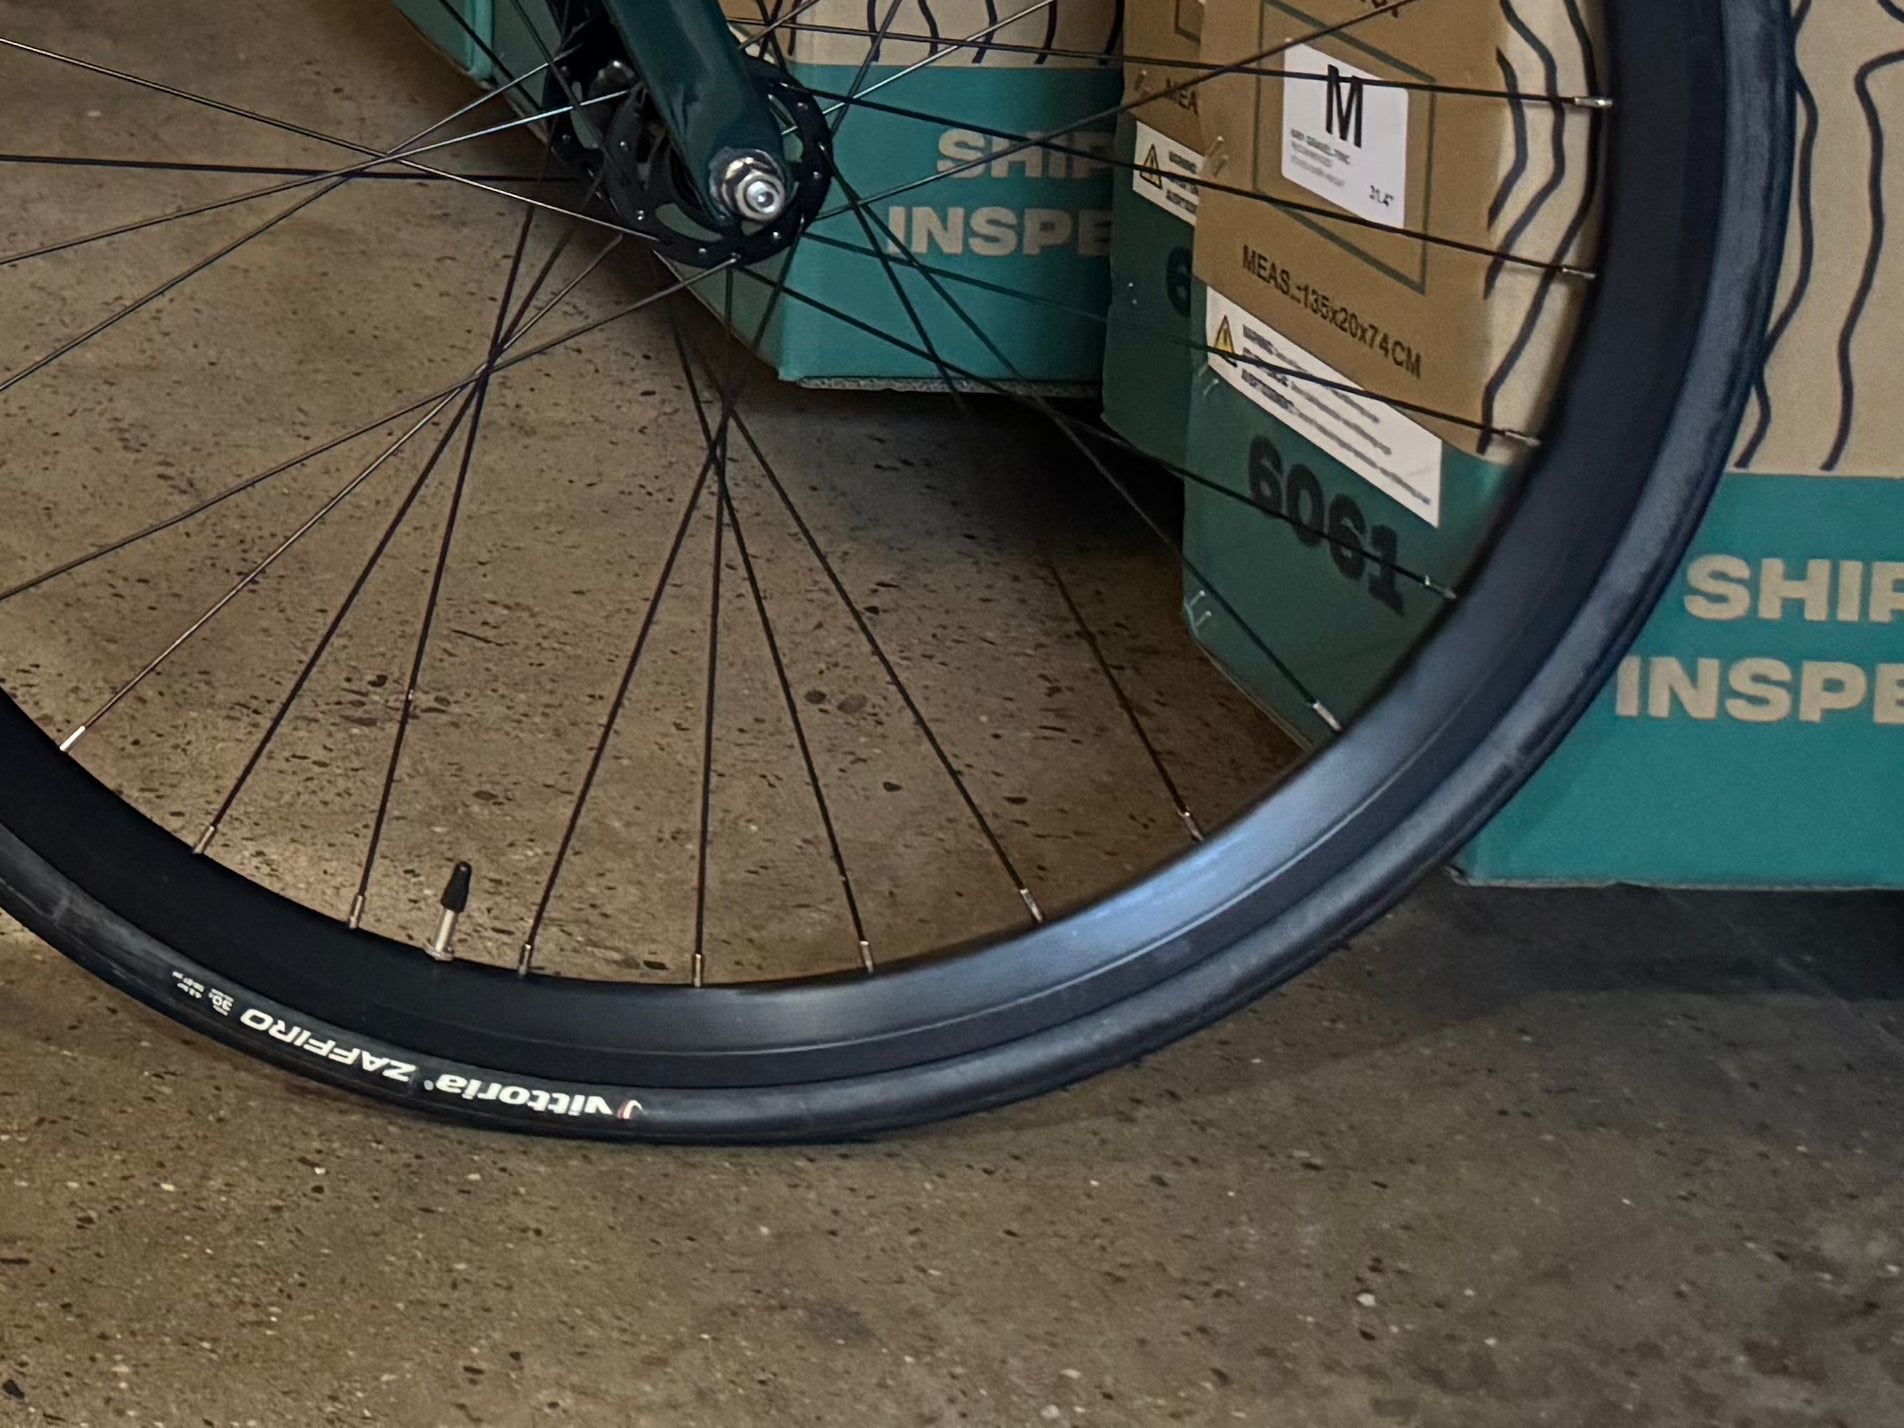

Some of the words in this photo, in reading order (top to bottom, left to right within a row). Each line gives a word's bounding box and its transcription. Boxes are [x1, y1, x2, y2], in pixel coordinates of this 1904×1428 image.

[1326, 65, 1364, 148] M
[1248, 434, 1405, 616] 6061
[240, 1007, 417, 1083] ZAFFIRO
